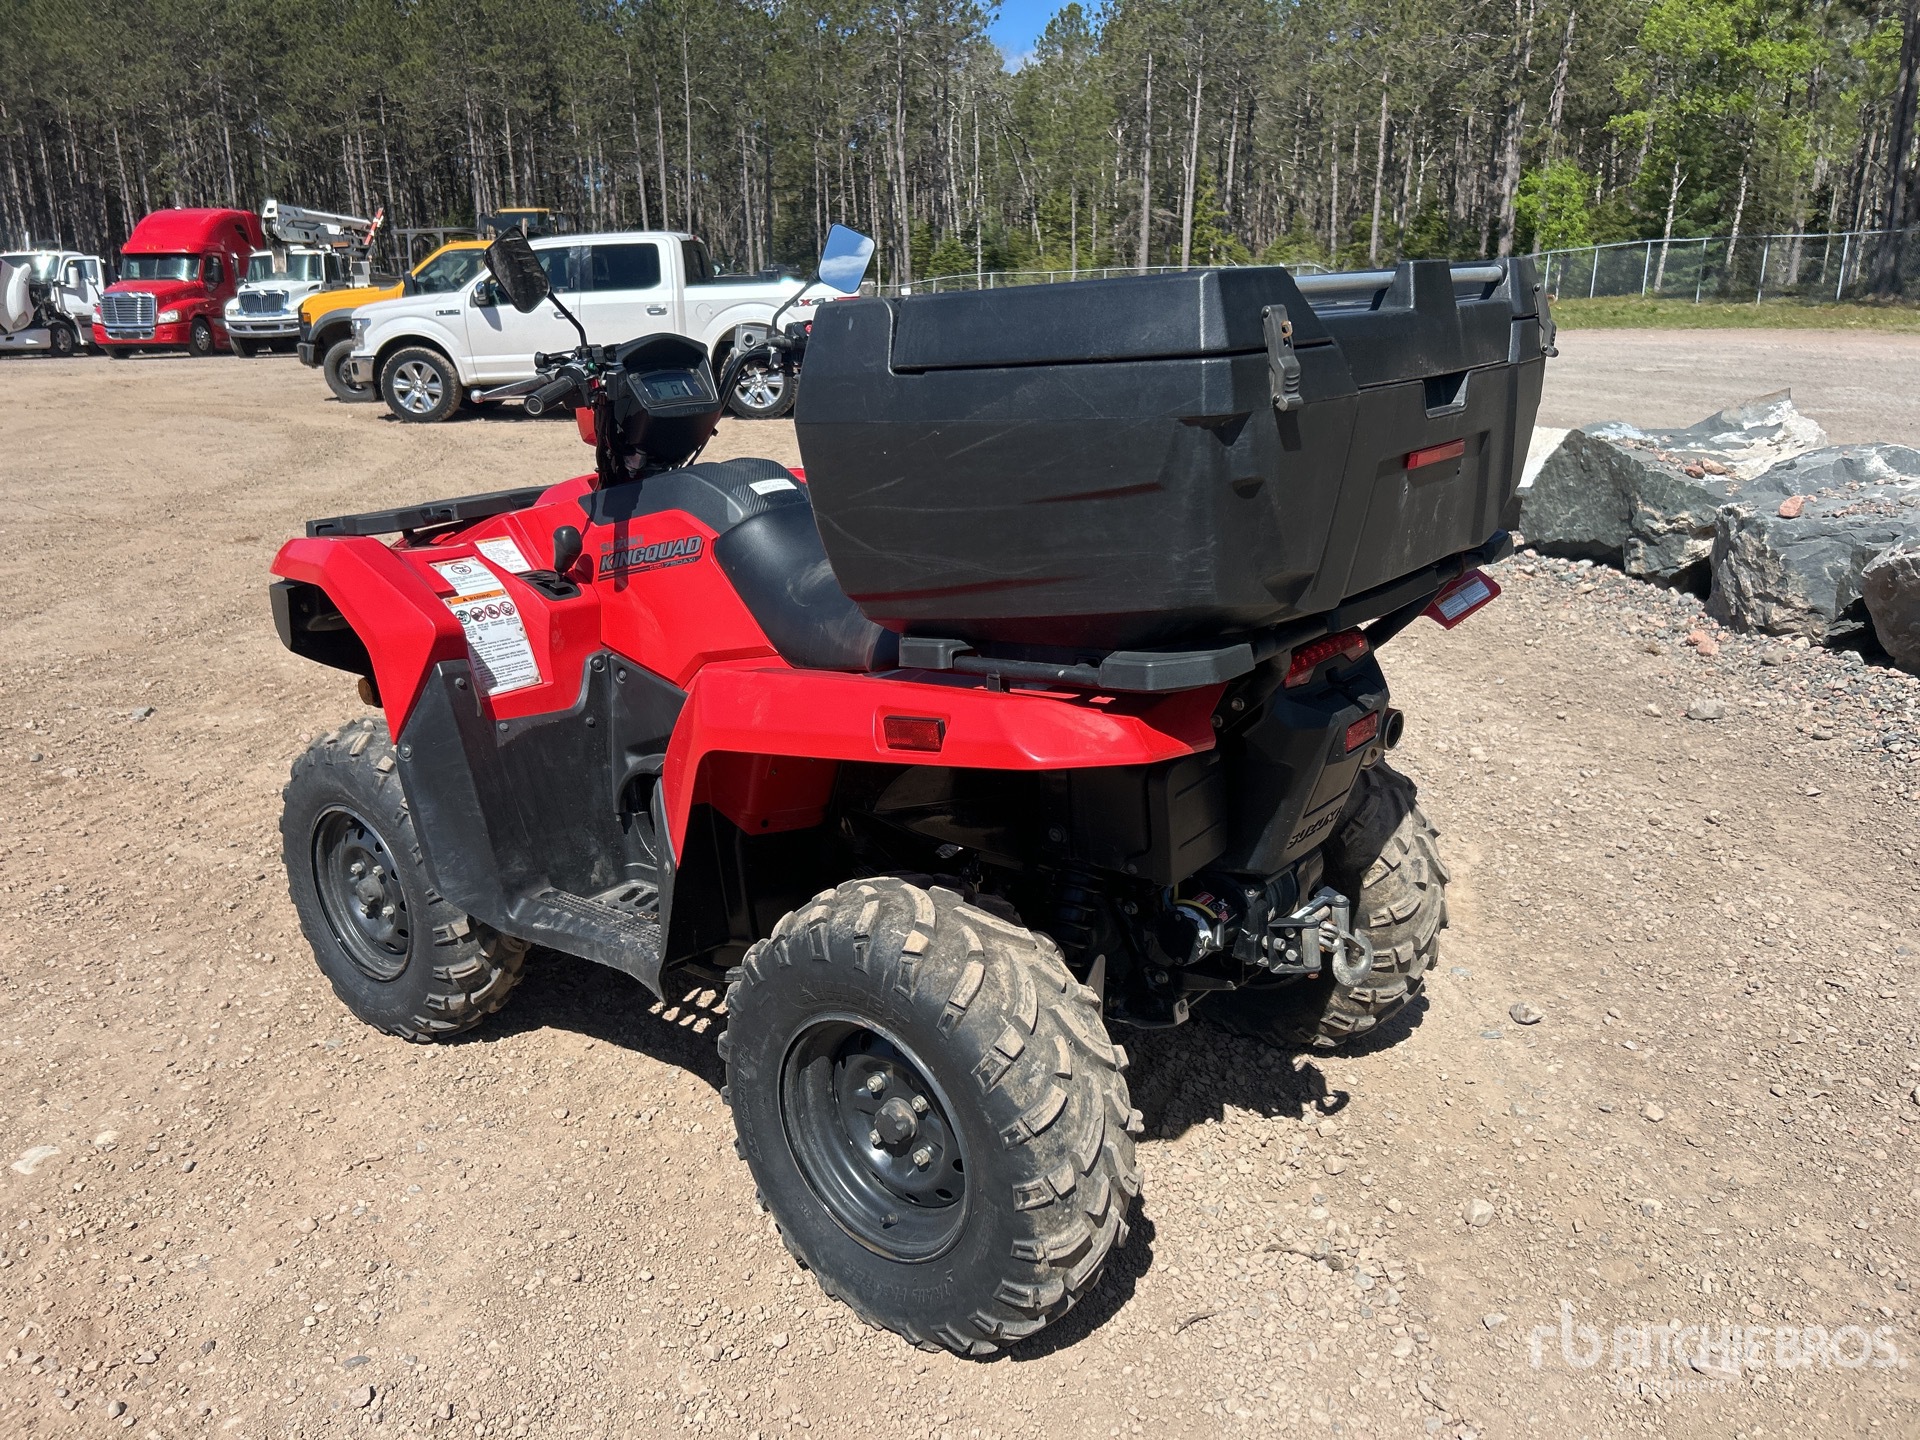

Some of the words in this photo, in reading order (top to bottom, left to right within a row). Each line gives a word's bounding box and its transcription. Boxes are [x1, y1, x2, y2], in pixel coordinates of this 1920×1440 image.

[600, 535, 643, 553] SUZUKI
[600, 536, 702, 573] KINGQUAD
[1286, 805, 1342, 850] SUZUKI
